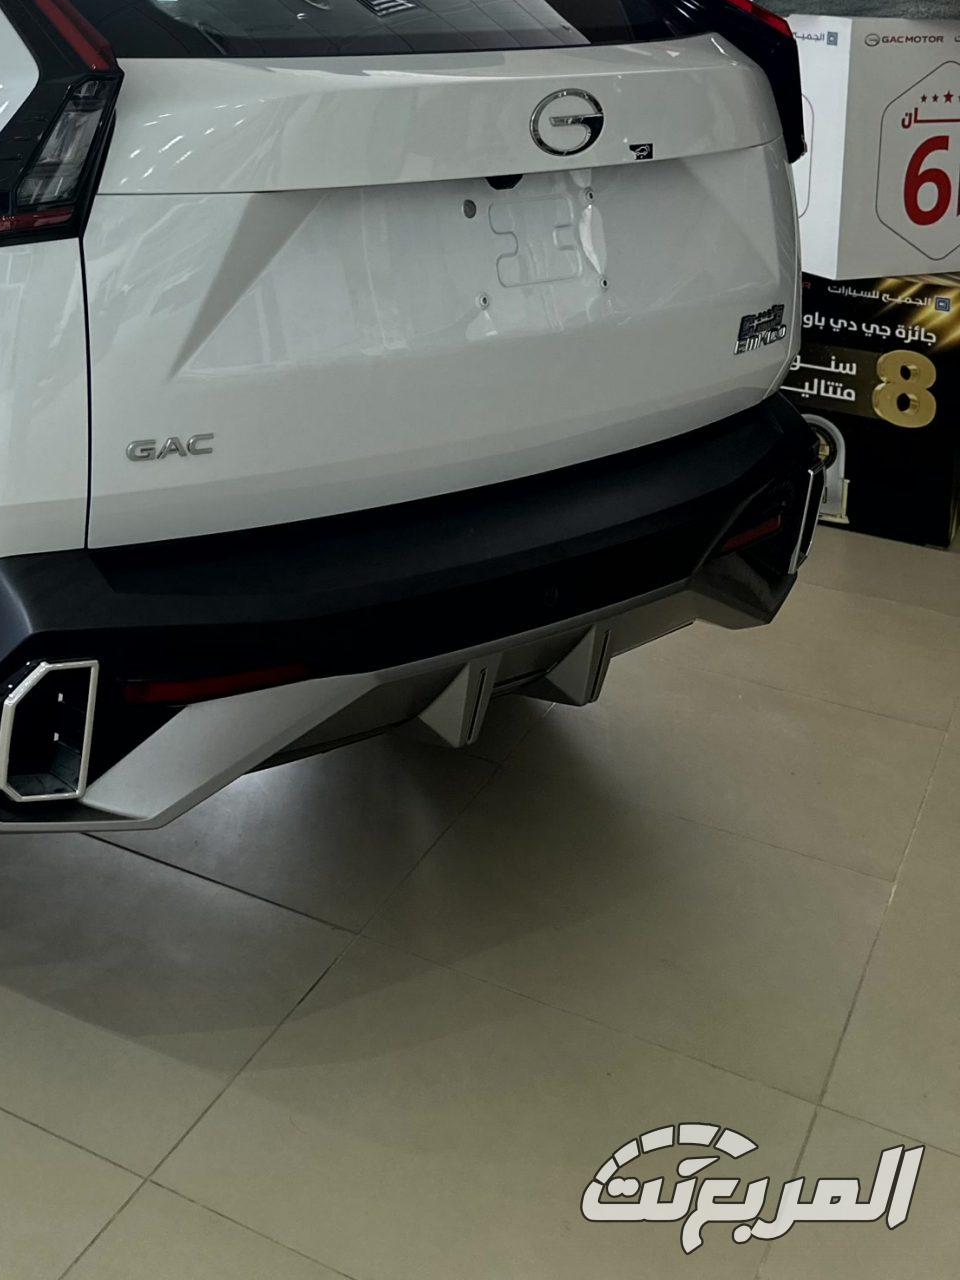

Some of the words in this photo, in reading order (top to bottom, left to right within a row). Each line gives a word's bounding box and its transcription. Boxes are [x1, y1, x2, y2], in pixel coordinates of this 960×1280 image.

[829, 316, 858, 332] دي
[861, 322, 892, 339] جي
[894, 323, 937, 347] جائزة
[780, 378, 856, 402] متتالي
[872, 349, 937, 429] 8
[125, 432, 215, 462] GAC
